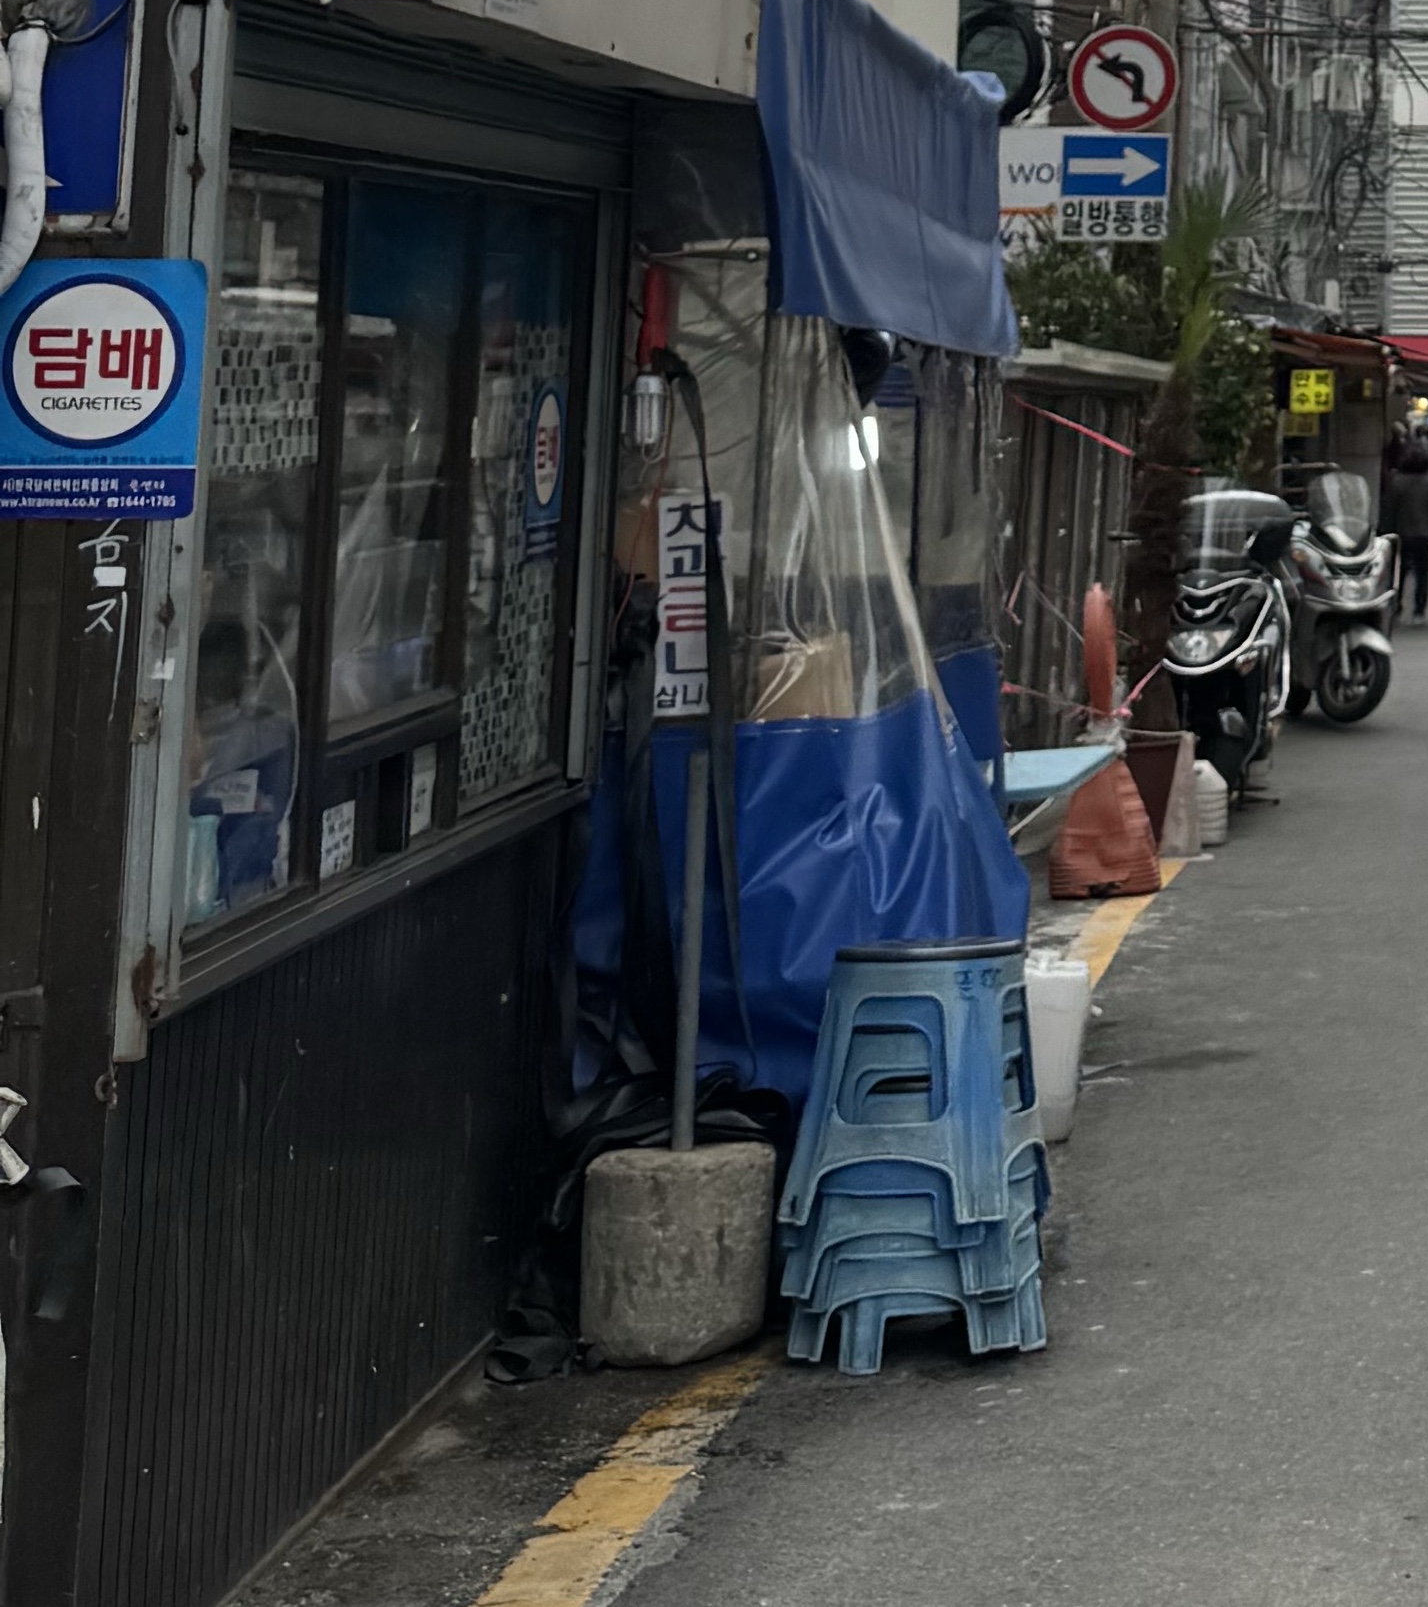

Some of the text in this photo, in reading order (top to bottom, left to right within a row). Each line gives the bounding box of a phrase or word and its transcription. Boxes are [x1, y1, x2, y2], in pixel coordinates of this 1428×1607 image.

[1008, 162, 1061, 184] WO
[1061, 201, 1165, 237] 일방통행
[29, 328, 163, 390] 담배
[41, 396, 142, 410] CIGARETTES
